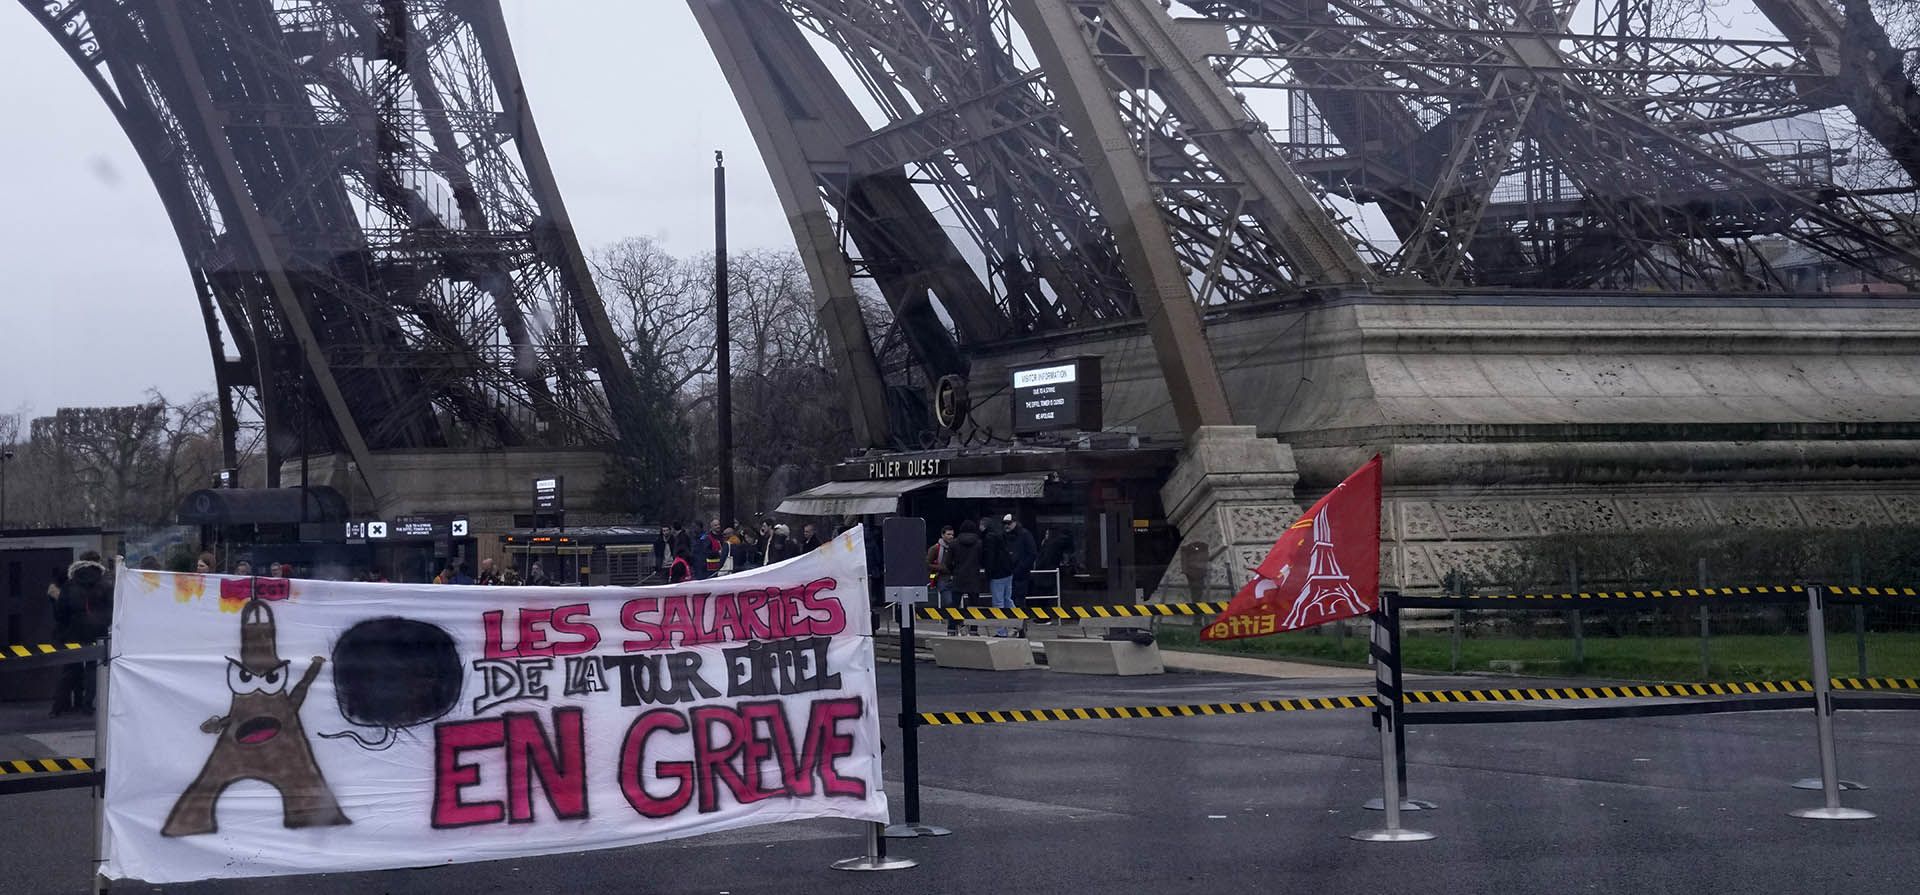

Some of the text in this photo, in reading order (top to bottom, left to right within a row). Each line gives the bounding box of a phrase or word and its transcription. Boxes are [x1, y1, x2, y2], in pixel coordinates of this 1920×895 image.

[1022, 370, 1067, 383] VISITOR INFORMATION
[869, 459, 940, 478] PILIER OUEST
[254, 583, 286, 596] CGT
[483, 603, 601, 660] LES
[473, 657, 553, 713] DE
[562, 655, 609, 696] LA
[602, 651, 722, 709] TOUR
[431, 696, 867, 829] EN GREVE
